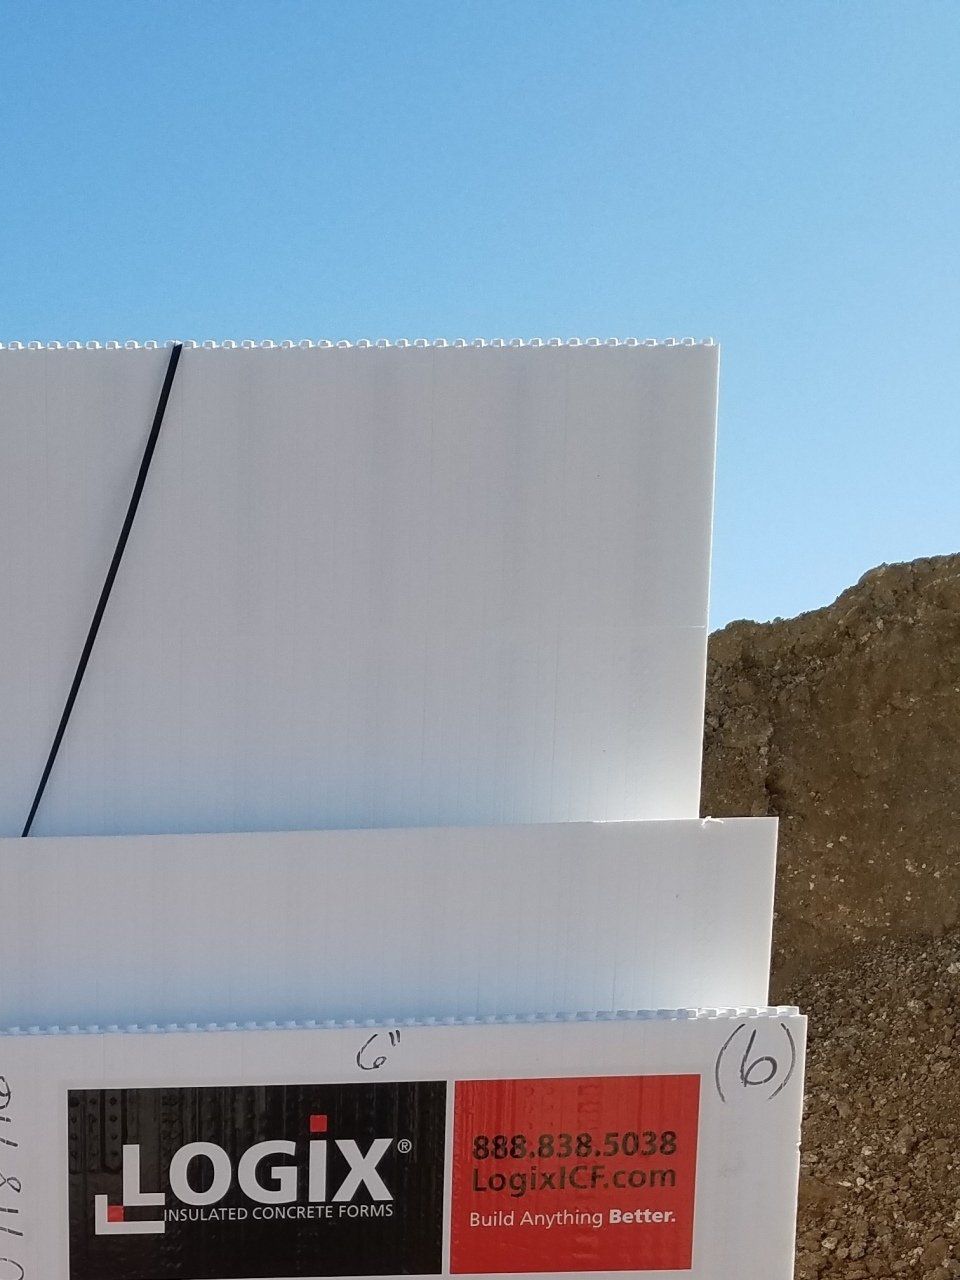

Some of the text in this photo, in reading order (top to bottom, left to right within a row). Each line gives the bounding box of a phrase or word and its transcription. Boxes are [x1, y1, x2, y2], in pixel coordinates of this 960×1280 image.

[356, 1029, 401, 1071] 6"
[472, 1130, 677, 1160] 888.838.5038
[472, 1165, 677, 1198] LogixICF.com
[163, 1204, 394, 1222] INSULATED CONCRETE FORMS
[470, 1209, 676, 1229] Build Anything Better.
